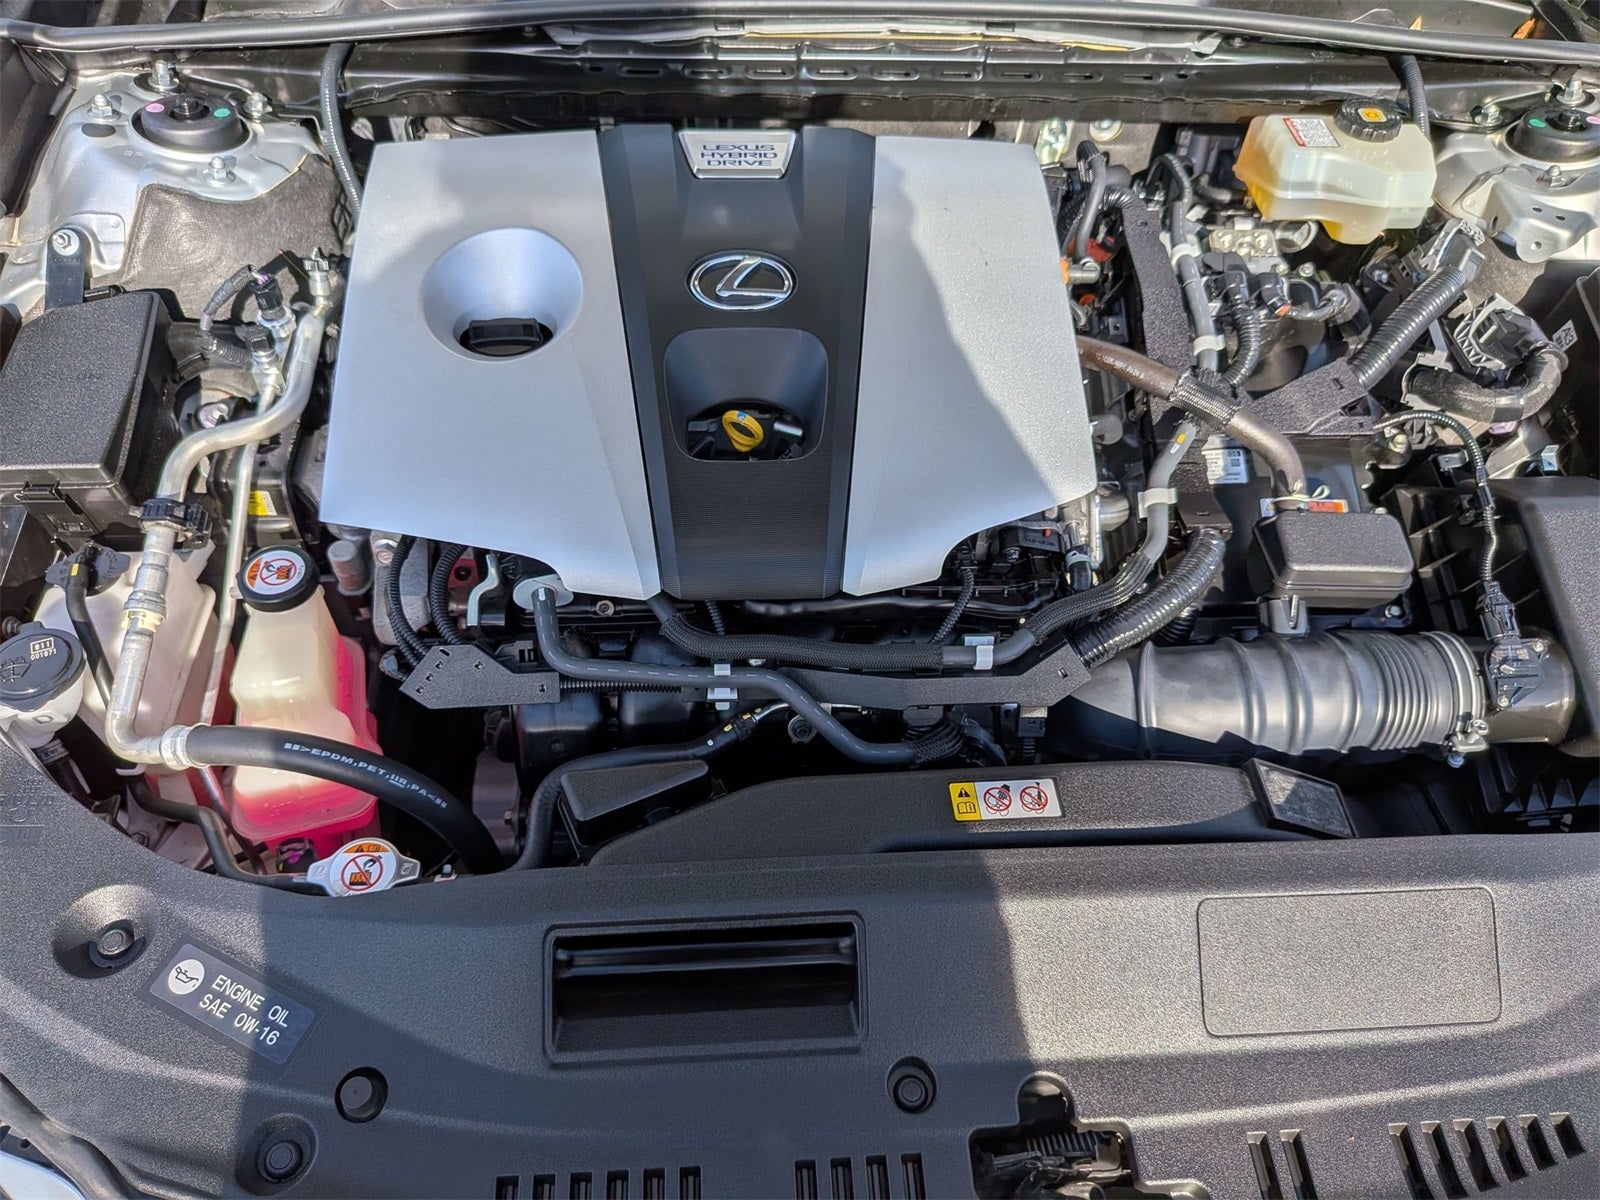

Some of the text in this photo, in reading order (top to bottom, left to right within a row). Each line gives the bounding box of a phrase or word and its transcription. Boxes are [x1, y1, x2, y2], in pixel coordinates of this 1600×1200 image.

[200, 993, 280, 1046] SAE 0W-16
[212, 974, 289, 1028] ENGINE OIL
